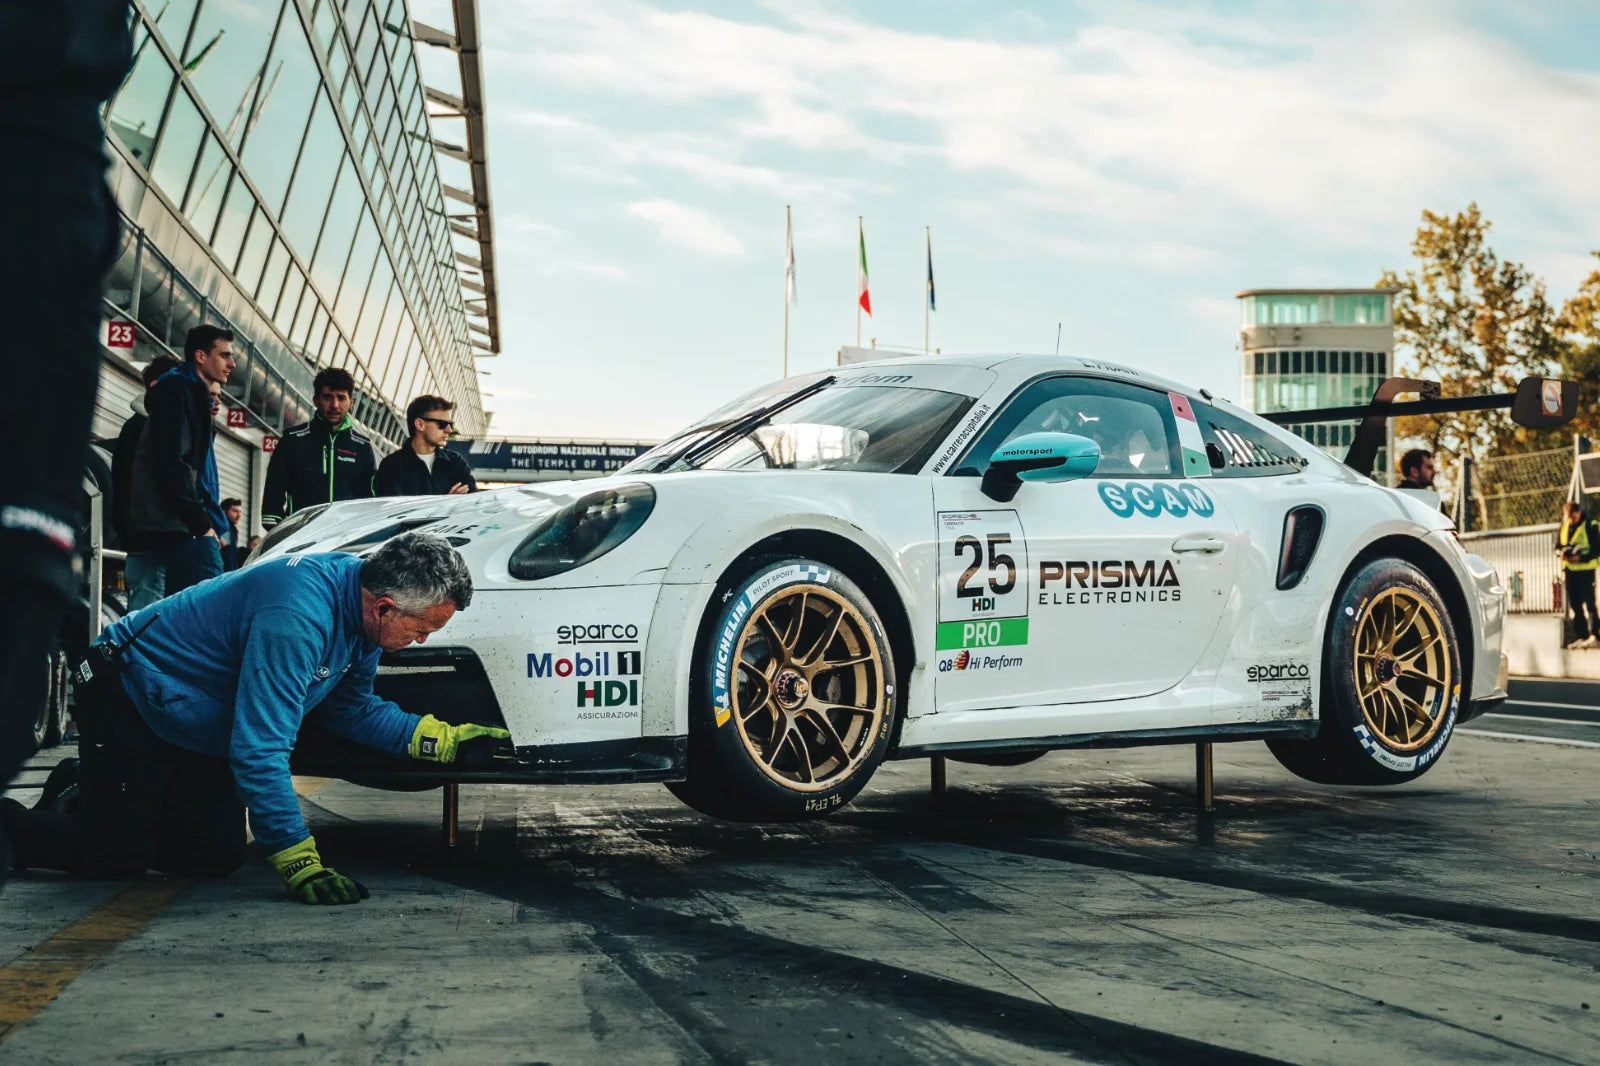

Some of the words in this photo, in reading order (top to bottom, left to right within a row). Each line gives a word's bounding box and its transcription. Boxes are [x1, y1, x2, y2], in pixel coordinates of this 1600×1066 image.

[111, 326, 132, 342] 23
[230, 411, 244, 423] 21
[932, 404, 991, 474] www.carreracupitalia.it
[511, 445, 558, 455] AUTODROMO
[560, 446, 607, 456] NAZIONALE
[608, 446, 636, 457] MONZA
[1003, 448, 1053, 456] motorsport
[511, 458, 530, 467] THE
[538, 459, 577, 469] TEMPLE
[583, 459, 597, 469] OF
[604, 460, 630, 470] SPE
[1103, 486, 1211, 511] SCAM
[954, 533, 1016, 598] 25
[1039, 559, 1180, 589] PRISMA
[752, 579, 771, 595] PILOT
[771, 570, 793, 583] SPORT
[972, 597, 995, 611] HDI
[1038, 590, 1181, 605] ELECTRONICS
[556, 624, 638, 645] sparco
[715, 600, 748, 689] MICHELIN
[962, 621, 1001, 647] PRO
[527, 652, 609, 678] Mobil
[938, 660, 953, 672] Q8
[969, 658, 981, 669] Hi
[983, 655, 1023, 670] Perform
[1246, 664, 1309, 682] sparco
[577, 680, 638, 707] HDI
[577, 711, 638, 719] ASSICURAZIONI
[1418, 711, 1456, 766] MICHELIN
